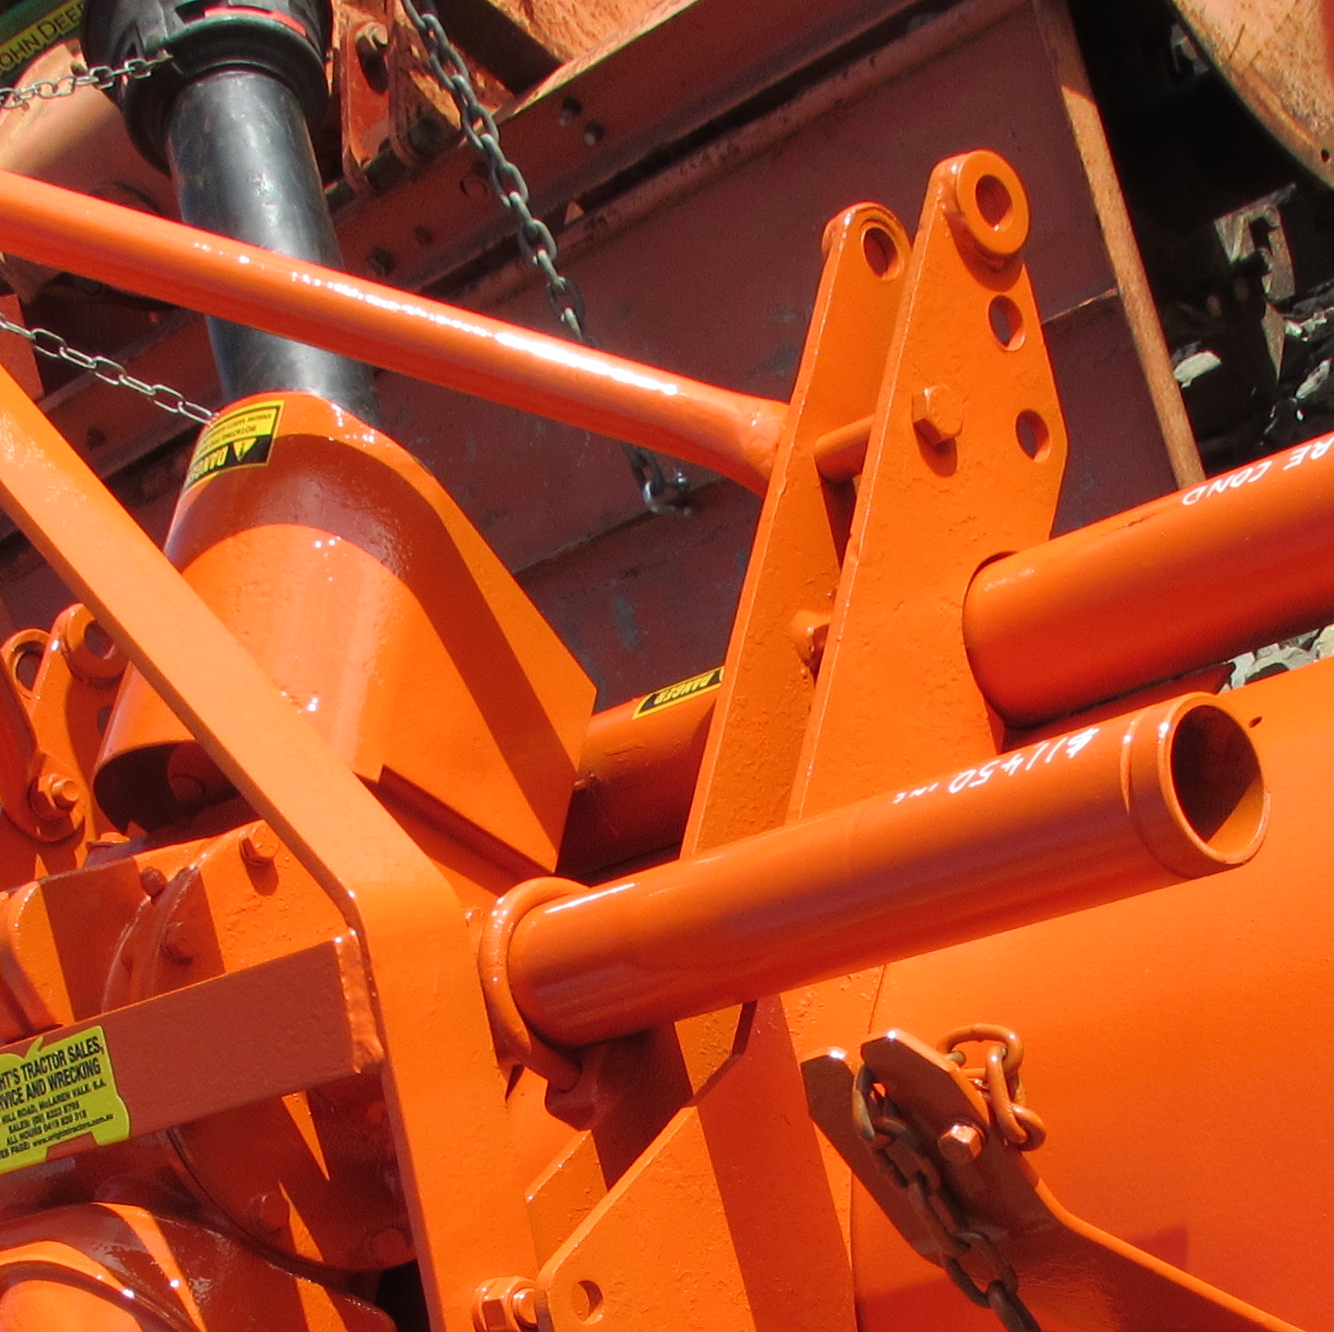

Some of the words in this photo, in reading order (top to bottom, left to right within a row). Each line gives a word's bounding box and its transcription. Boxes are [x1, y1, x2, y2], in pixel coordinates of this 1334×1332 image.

[38, 4, 83, 40] DEE
[1182, 460, 1273, 505] COND
[21, 1050, 68, 1082] TRACTOR
[68, 1036, 105, 1064] SALES,
[26, 1079, 47, 1101] AND
[47, 1057, 101, 1092] WRECKING
[7, 1135, 19, 1146] ALL
